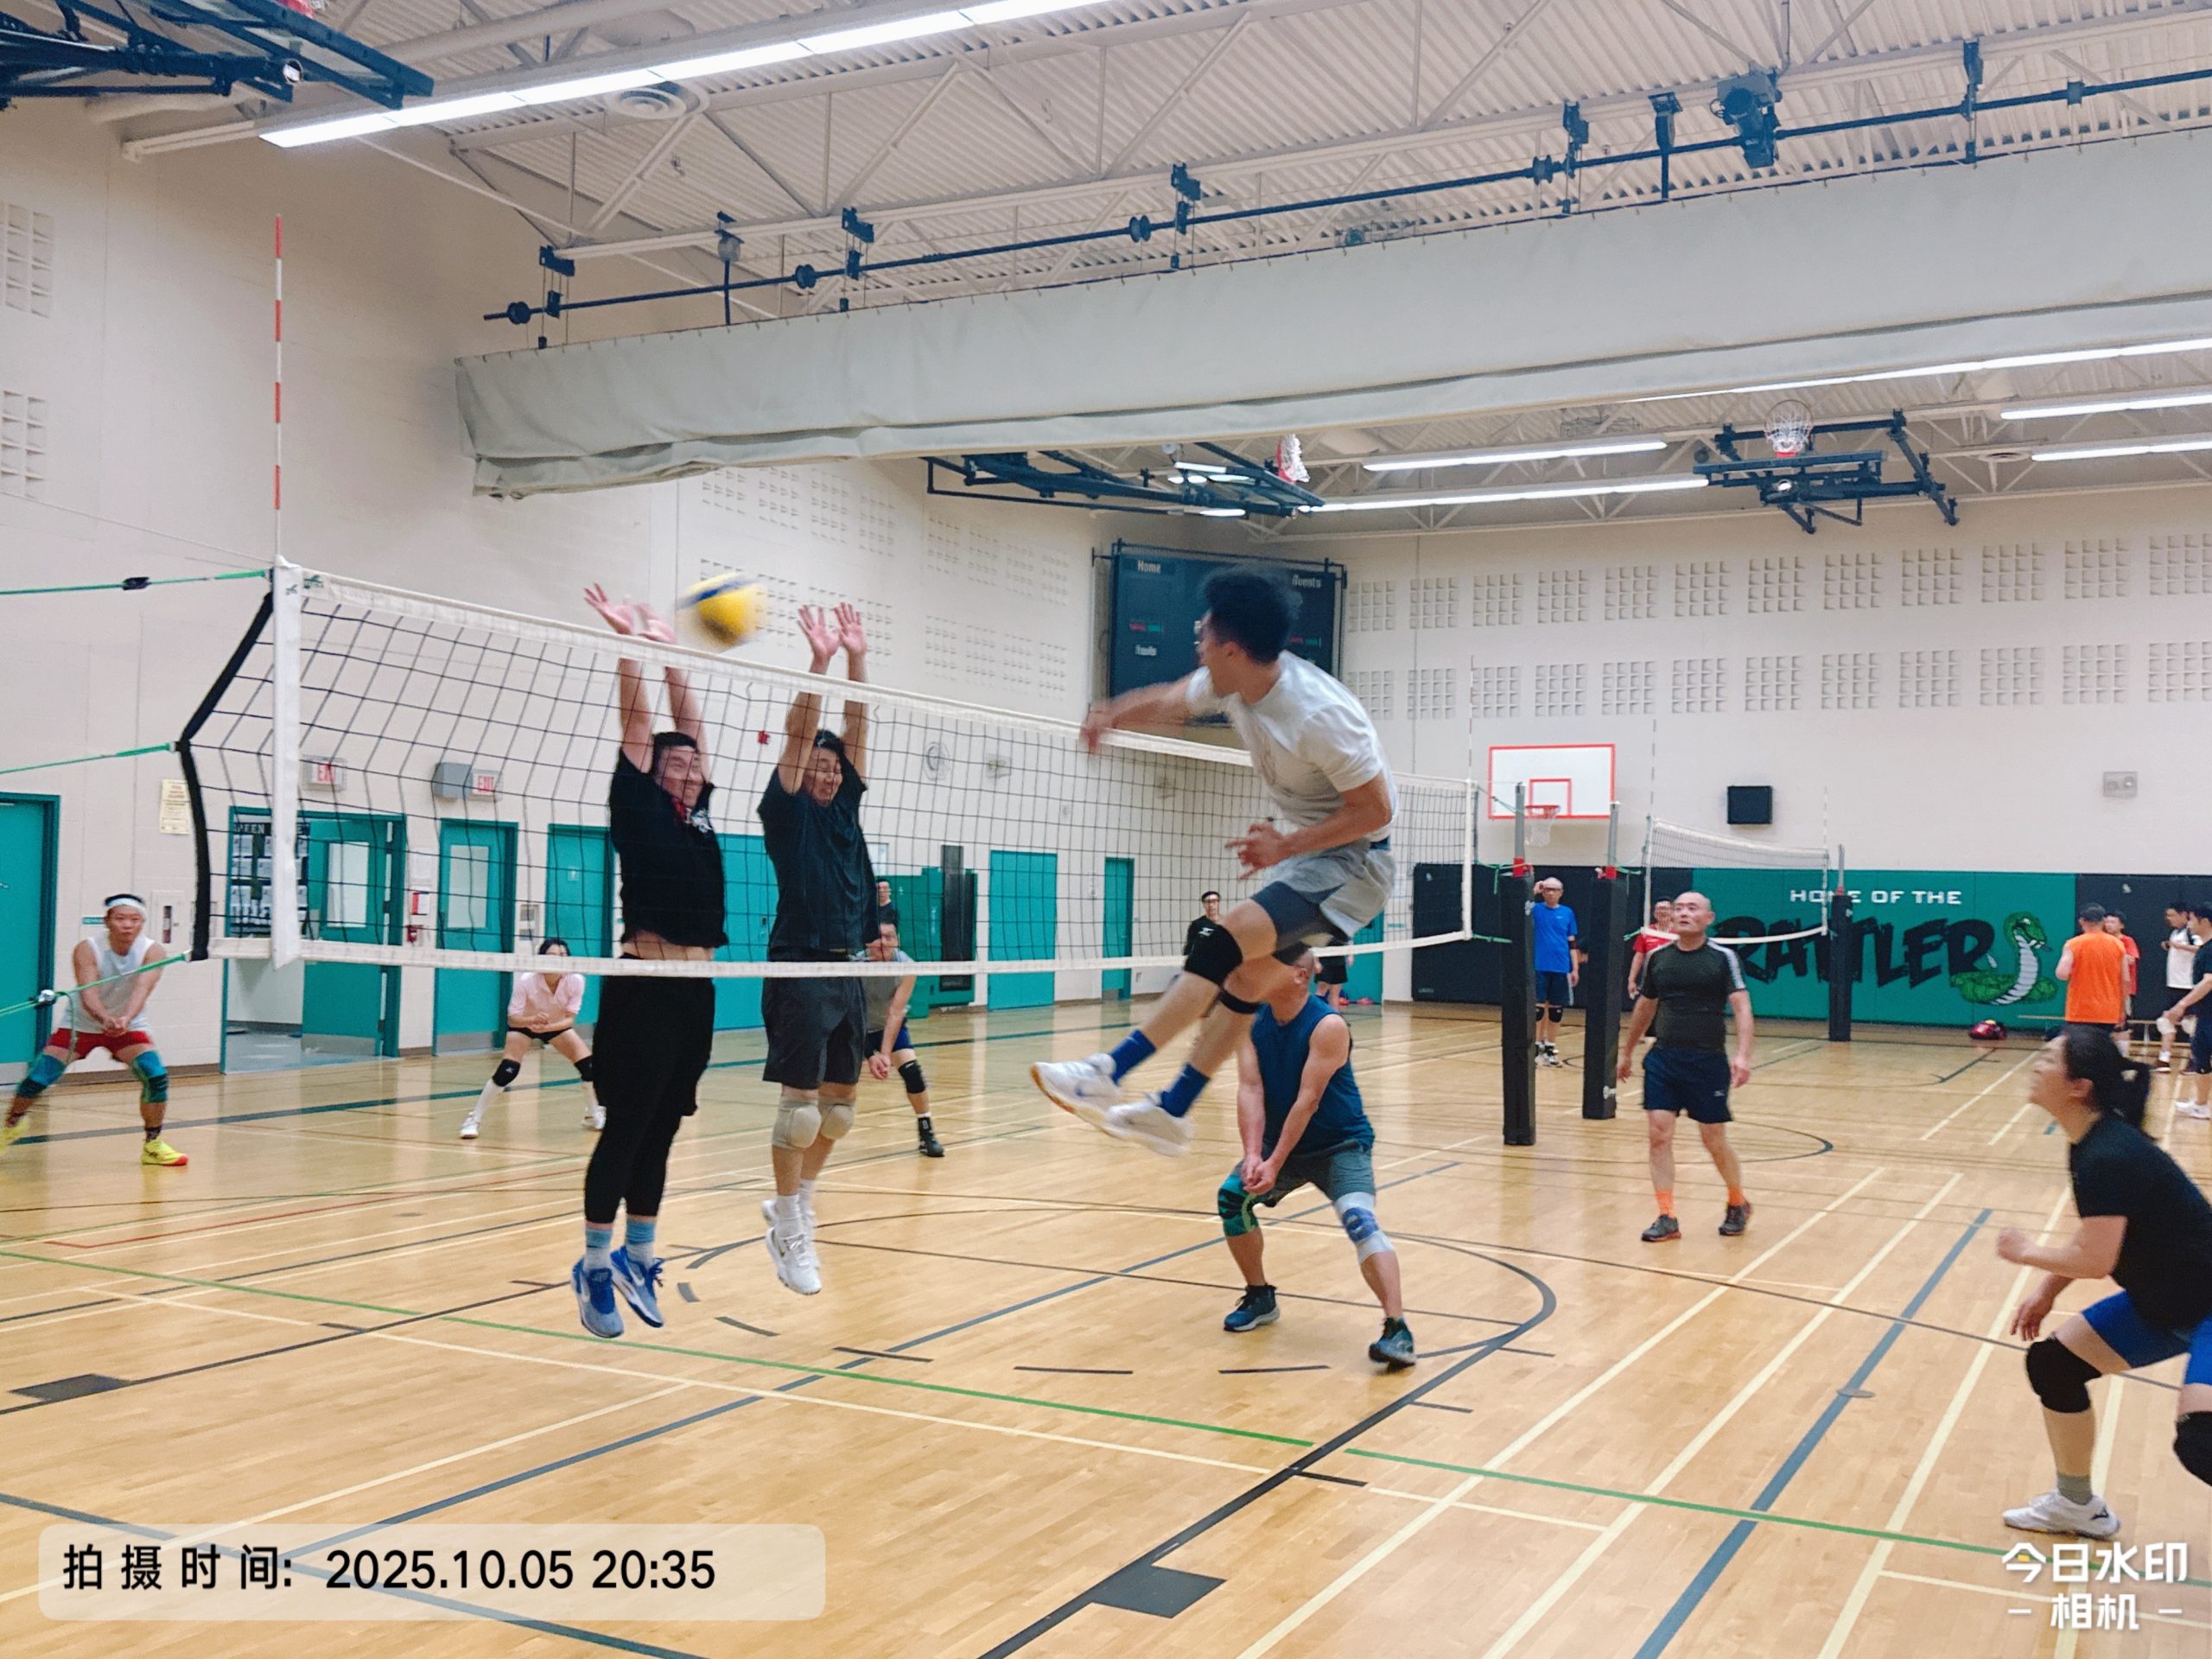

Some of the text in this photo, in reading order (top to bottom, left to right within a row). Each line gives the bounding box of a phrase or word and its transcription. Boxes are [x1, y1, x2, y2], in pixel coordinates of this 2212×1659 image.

[478, 775, 495, 791] EXIT
[1789, 890, 1962, 904] HOE OF THE
